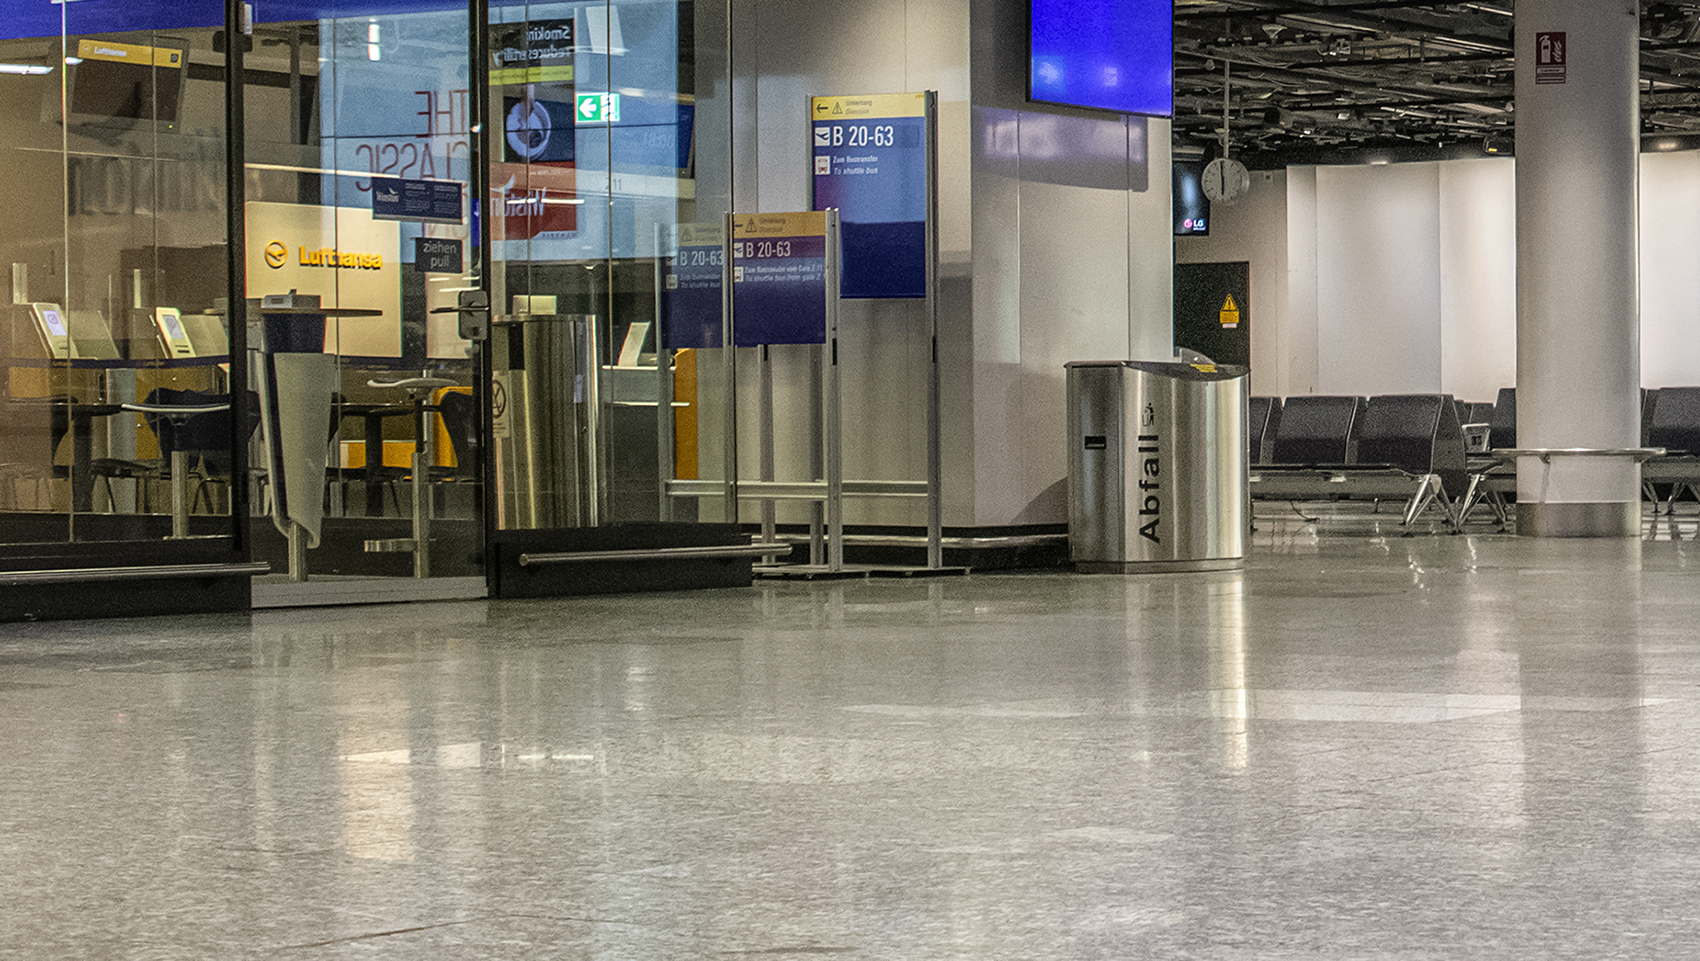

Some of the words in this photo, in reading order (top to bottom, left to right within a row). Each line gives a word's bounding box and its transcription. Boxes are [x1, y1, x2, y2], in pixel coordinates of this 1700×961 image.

[833, 126, 843, 146] B
[848, 126, 894, 147] 20-63
[1193, 219, 1205, 227] LG
[423, 241, 457, 254] ziehen
[746, 242, 754, 258] B
[757, 241, 791, 258] 20-63
[430, 254, 450, 269] pull
[680, 251, 688, 266] B
[691, 250, 723, 266] 20-63
[1138, 435, 1160, 545] Abfall
